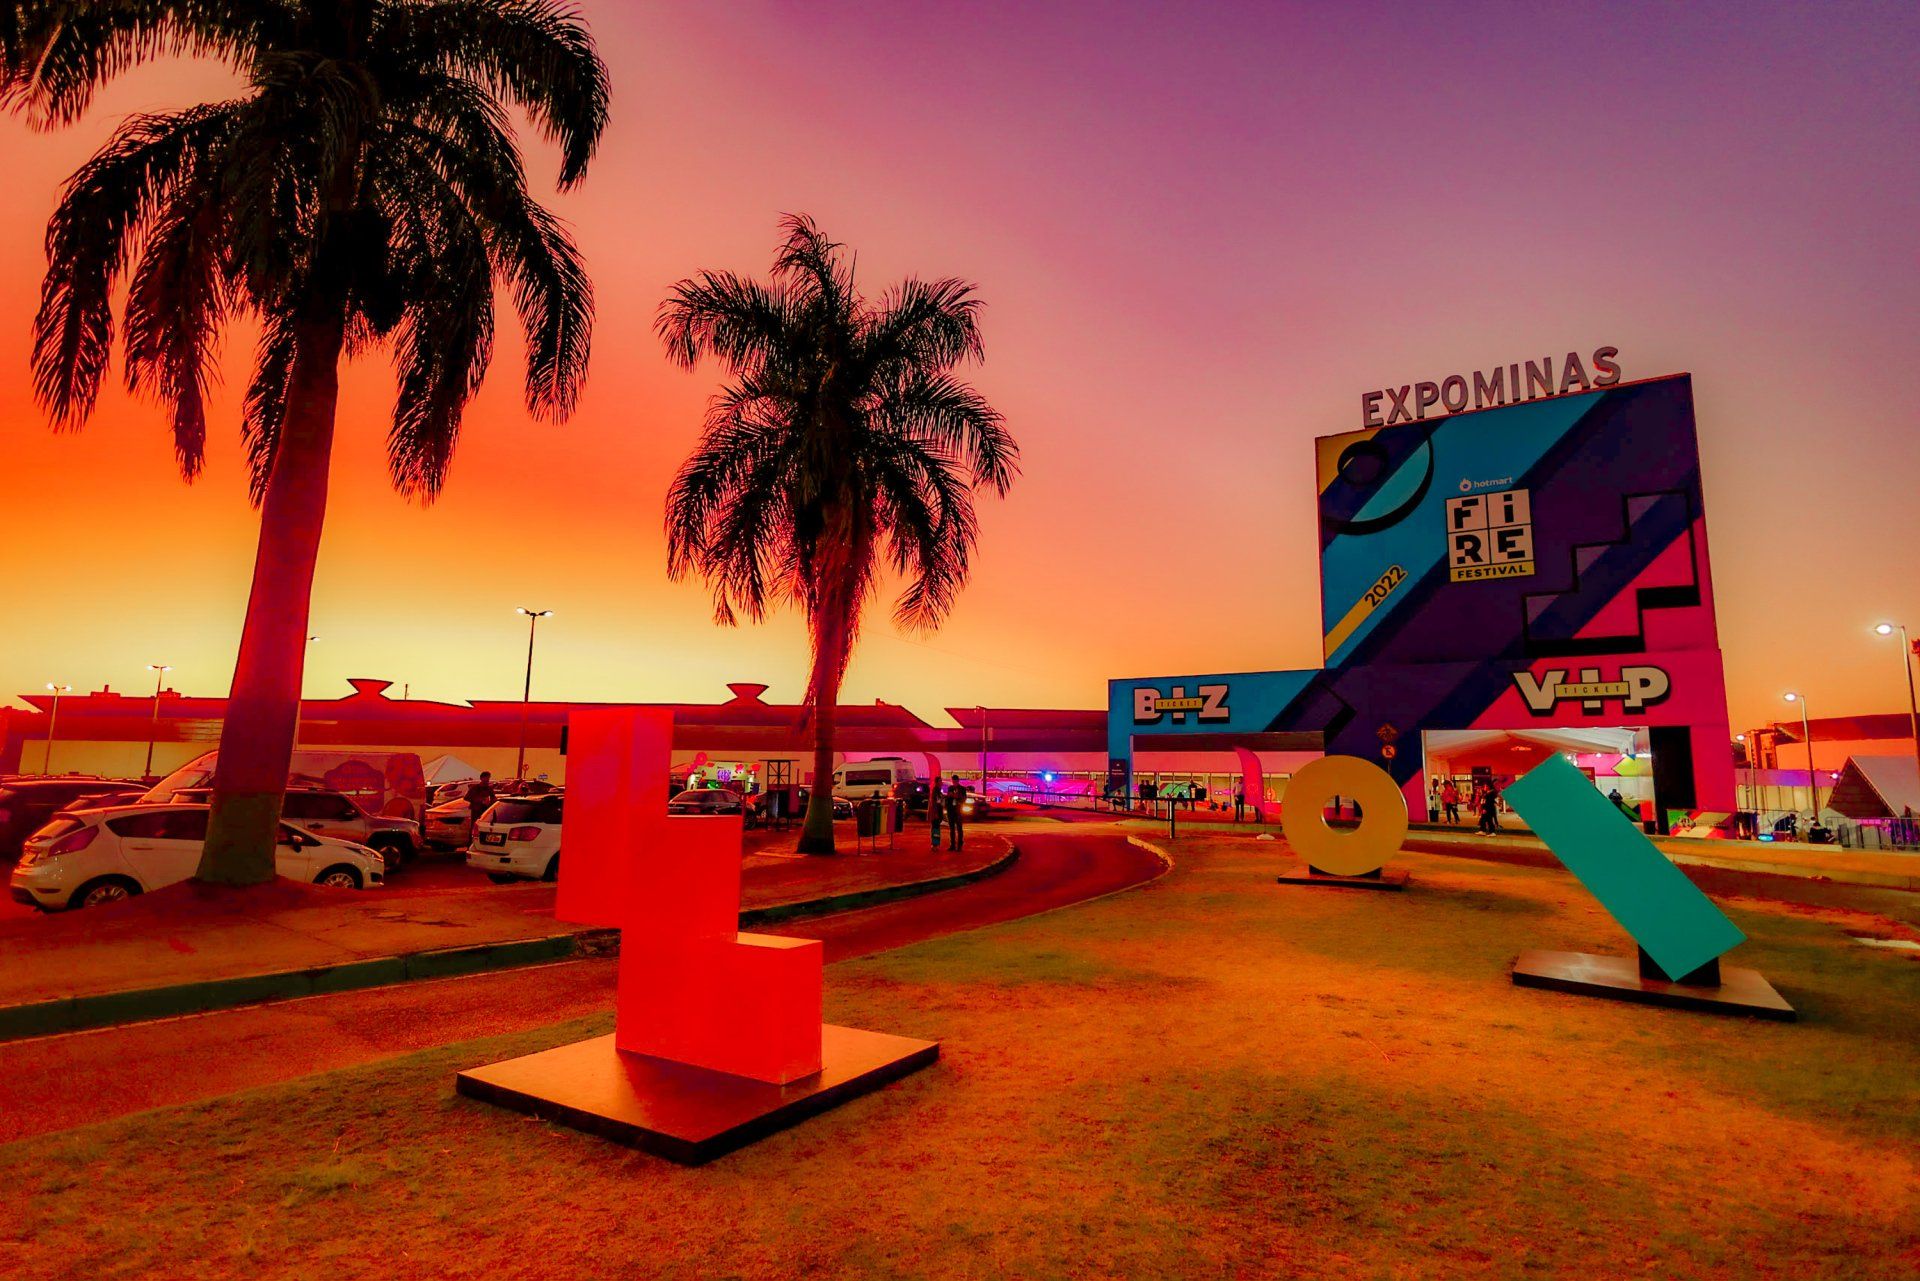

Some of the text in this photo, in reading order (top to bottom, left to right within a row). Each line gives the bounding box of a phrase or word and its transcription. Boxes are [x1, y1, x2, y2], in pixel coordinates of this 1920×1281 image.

[1361, 346, 1622, 428] EXPOMINAS
[1474, 477, 1513, 489] hotmart
[1457, 564, 1527, 579] FESTIVAL
[1364, 566, 1406, 607] 2022
[1512, 666, 1669, 711] VIP
[1563, 685, 1621, 695] TICKET
[1133, 684, 1230, 721] BIZ
[1160, 700, 1199, 708] TICKET
